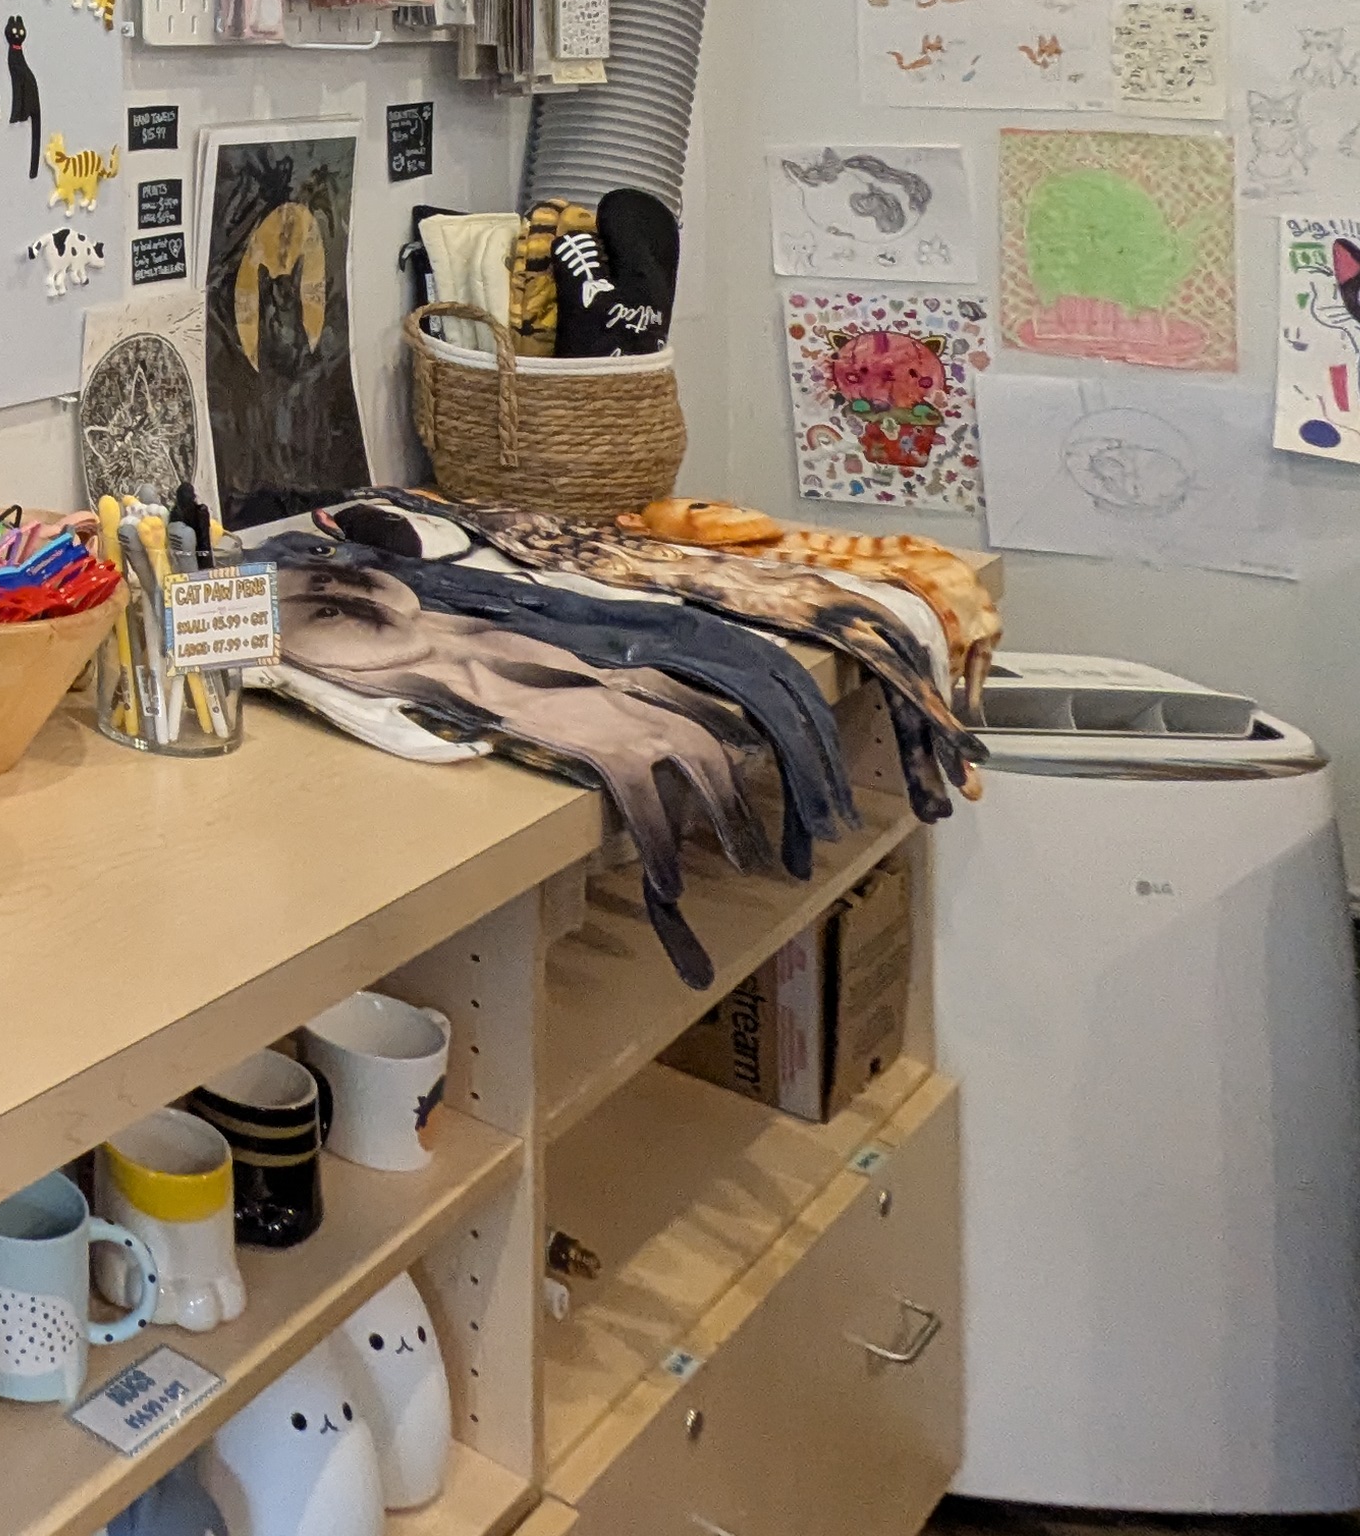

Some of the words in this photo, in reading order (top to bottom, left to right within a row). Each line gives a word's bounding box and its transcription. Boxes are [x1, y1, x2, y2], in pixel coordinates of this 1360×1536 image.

[174, 584, 202, 606] CAT
[203, 580, 234, 604] PAW
[235, 577, 267, 600] PENS
[250, 610, 269, 627] GST
[250, 633, 269, 650] GST
